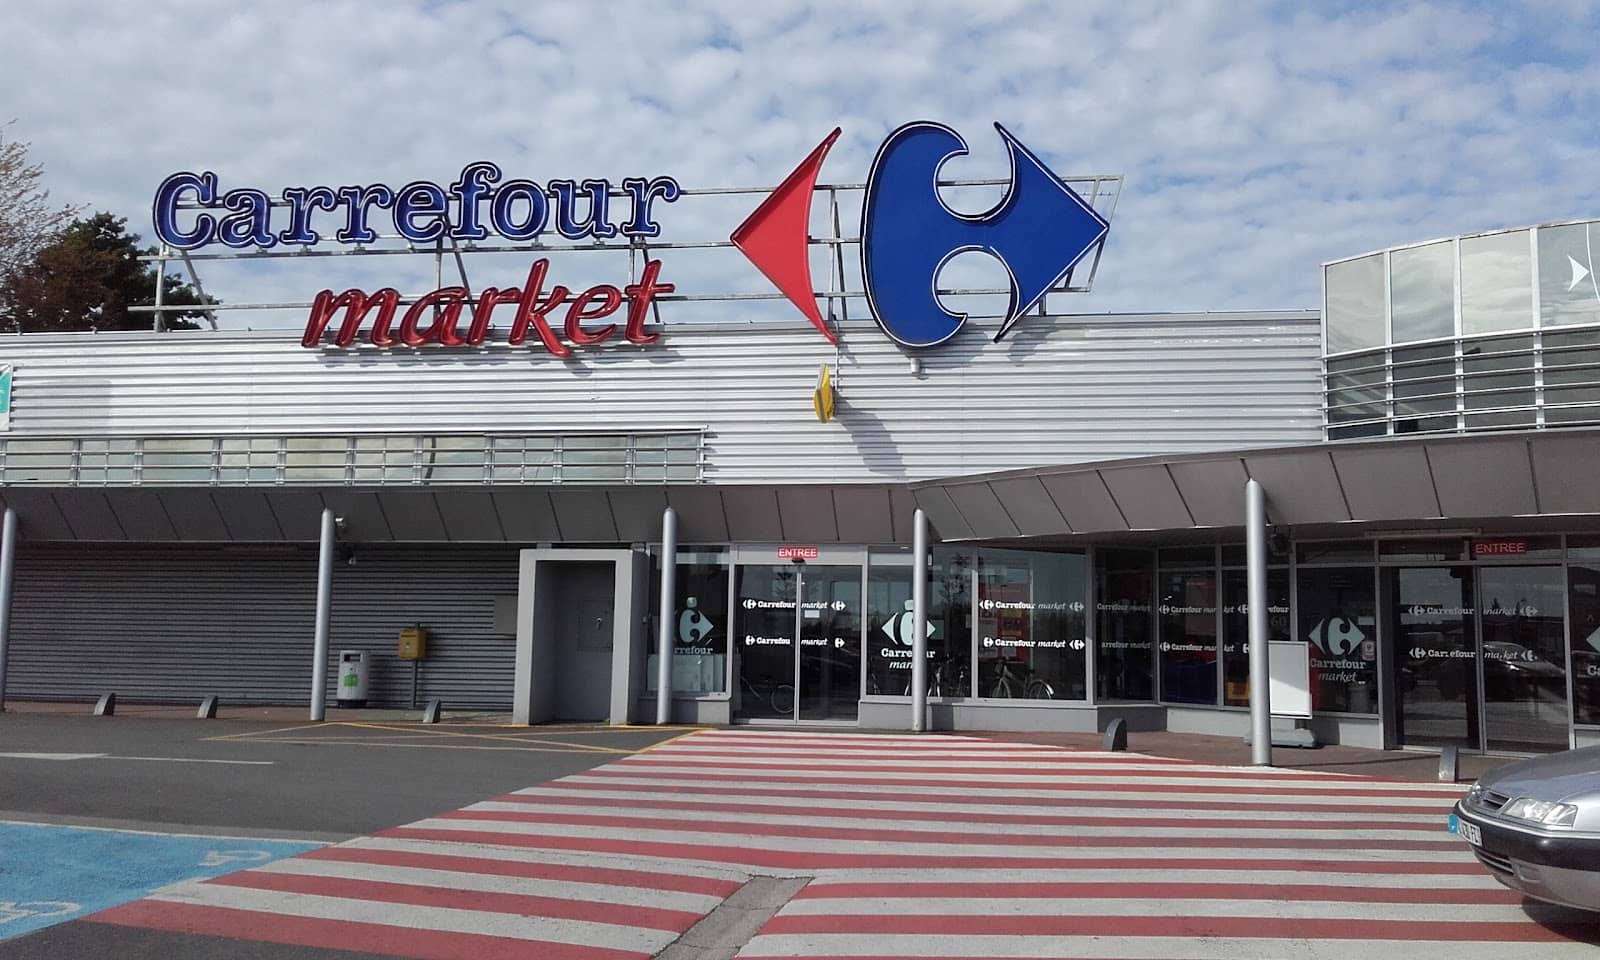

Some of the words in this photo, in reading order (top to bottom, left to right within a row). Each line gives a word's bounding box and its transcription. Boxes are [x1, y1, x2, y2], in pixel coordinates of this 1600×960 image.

[153, 161, 680, 249] Carrefour
[302, 258, 675, 358] market
[778, 548, 817, 557] ENTREE
[1475, 542, 1526, 553] ENTREE
[757, 600, 796, 609] Carrefour
[995, 601, 1035, 610] Carrefour
[1037, 602, 1066, 610] market
[1427, 607, 1475, 615] Carrefour
[994, 638, 1036, 648] Carrefour
[1037, 640, 1066, 649] market
[673, 646, 714, 655] rrefour
[881, 648, 937, 659] Carreur
[889, 660, 914, 669] mar
[1309, 658, 1367, 669] Carrefour
[1318, 670, 1357, 683] market
